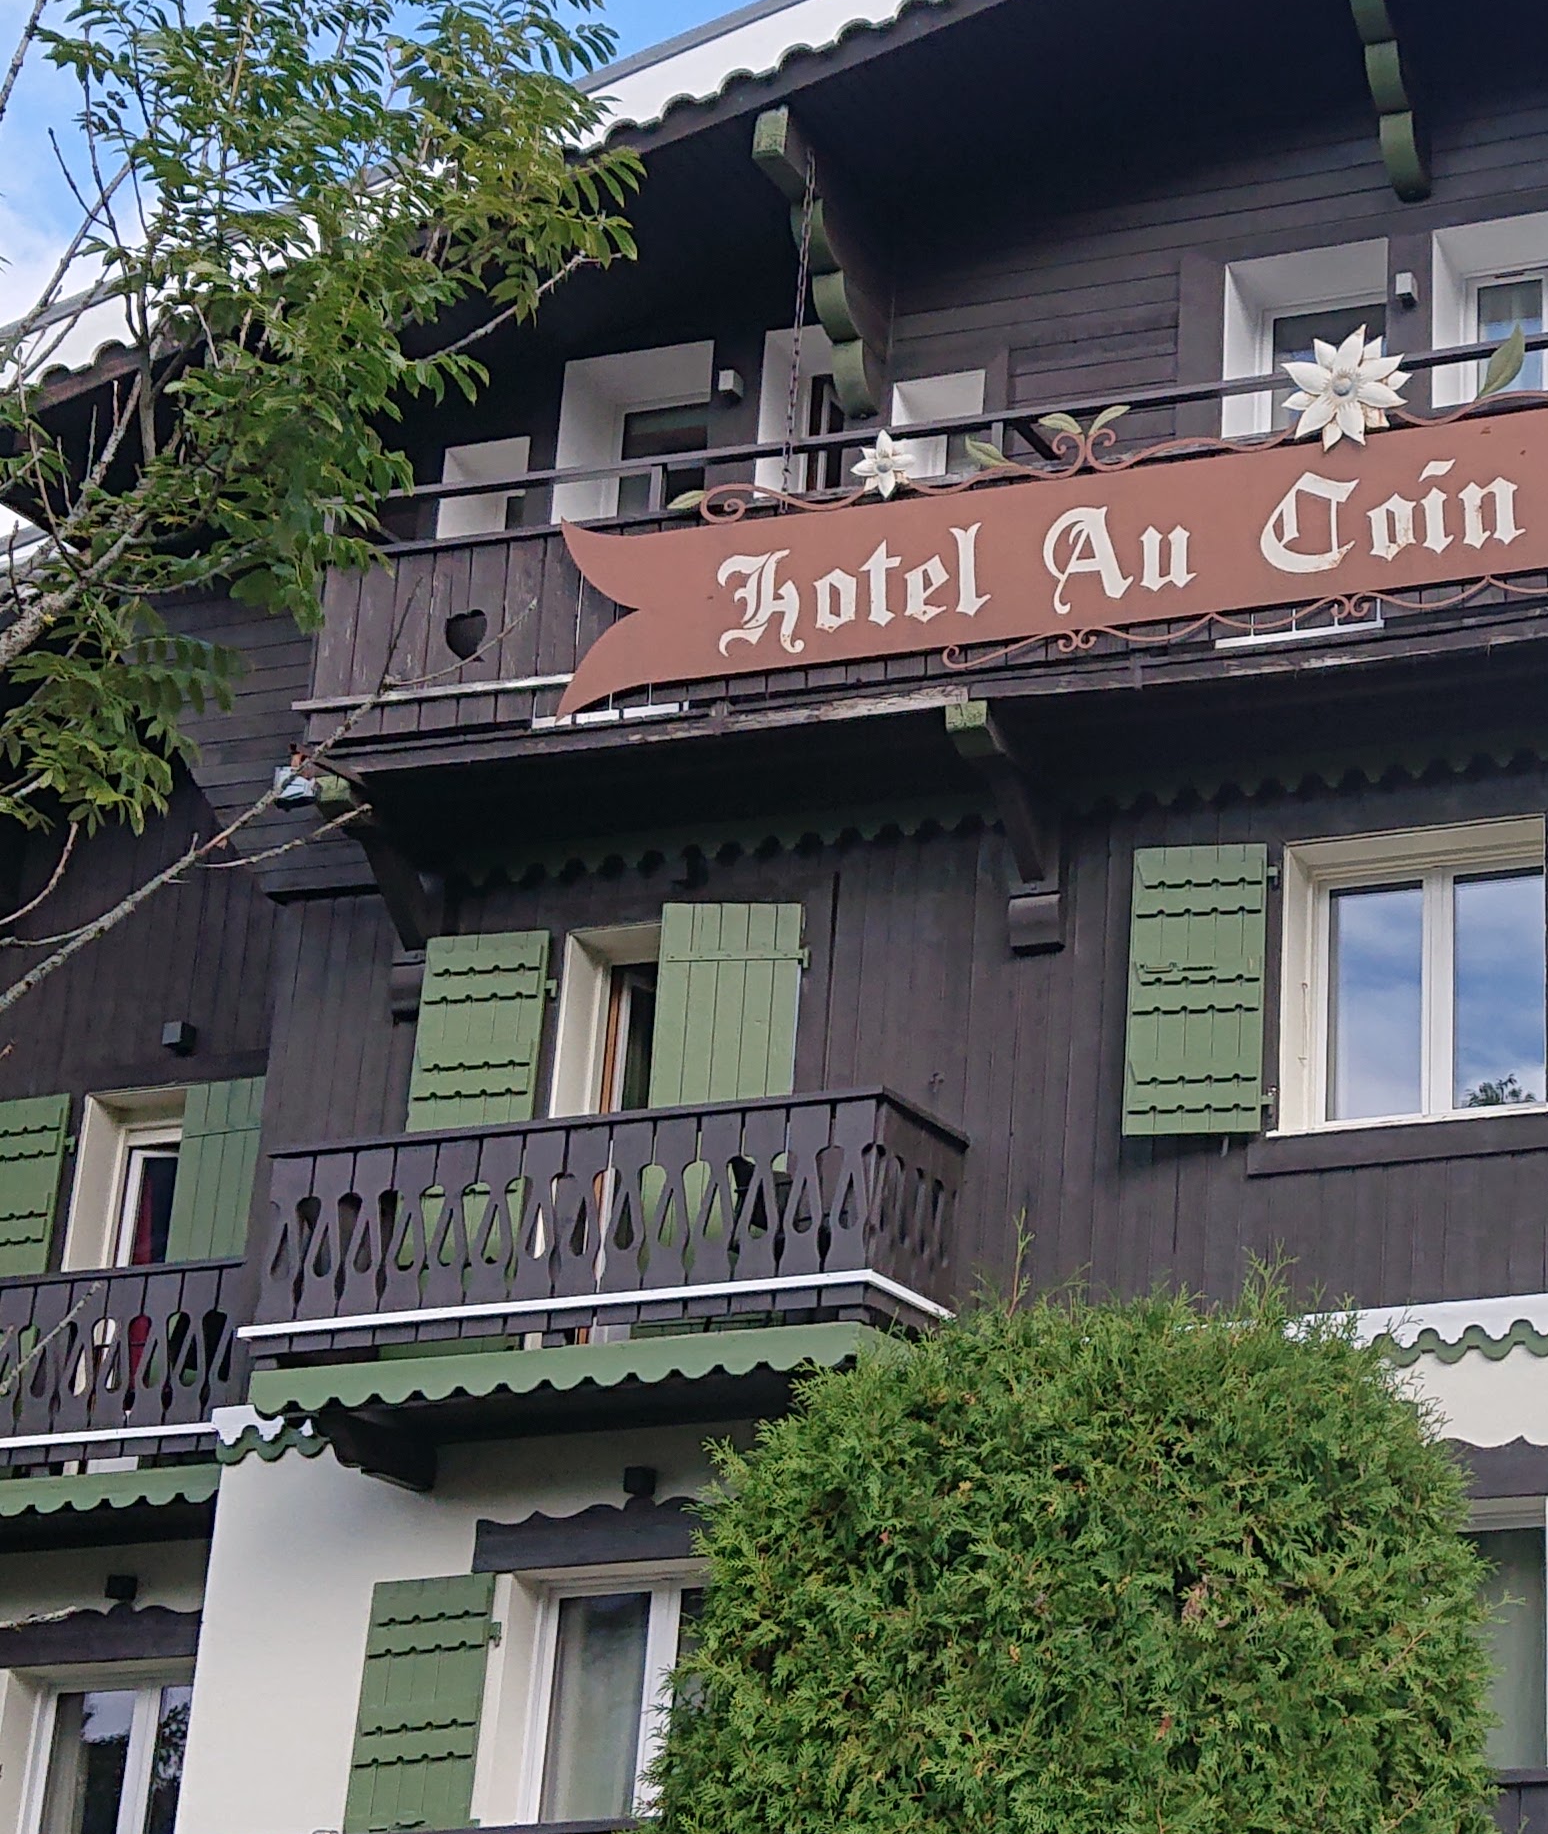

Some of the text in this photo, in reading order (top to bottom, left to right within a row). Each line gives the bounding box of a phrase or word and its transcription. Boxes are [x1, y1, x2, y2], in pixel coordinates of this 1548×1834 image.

[717, 521, 991, 658] Hotel
[1042, 505, 1197, 615] Au
[1259, 458, 1527, 574] Coin
